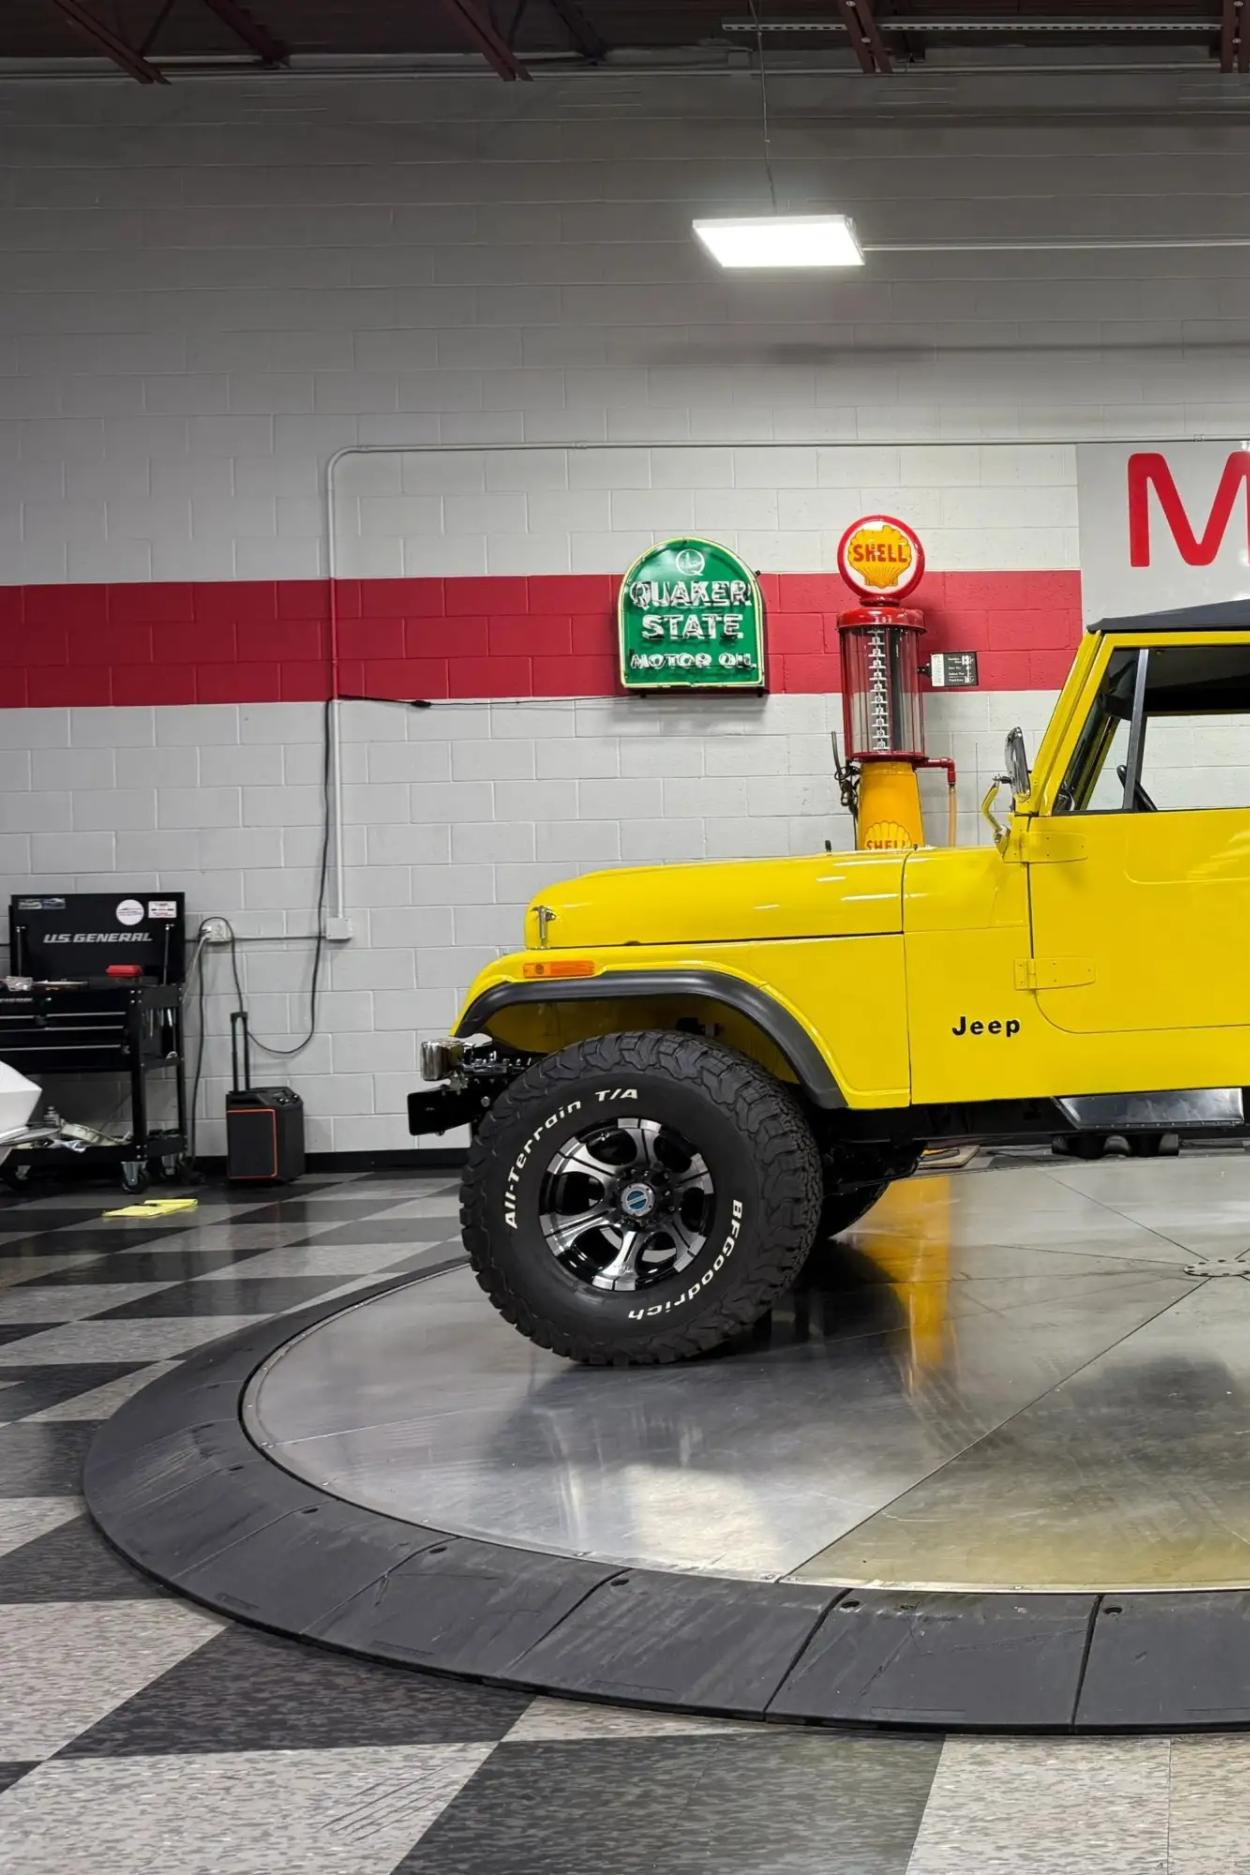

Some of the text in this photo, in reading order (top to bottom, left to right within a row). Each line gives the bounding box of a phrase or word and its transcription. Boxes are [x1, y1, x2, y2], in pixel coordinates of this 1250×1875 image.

[853, 543, 908, 563] SHELL
[629, 579, 752, 610] QUAKER
[641, 613, 744, 640] STATE
[630, 652, 757, 669] MOTOR OIL
[73, 932, 153, 943] GENERAL
[951, 1016, 1021, 1038] Jeep
[504, 1088, 639, 1230] All-Terrain T/A
[628, 1199, 743, 1321] BFGoodrich
